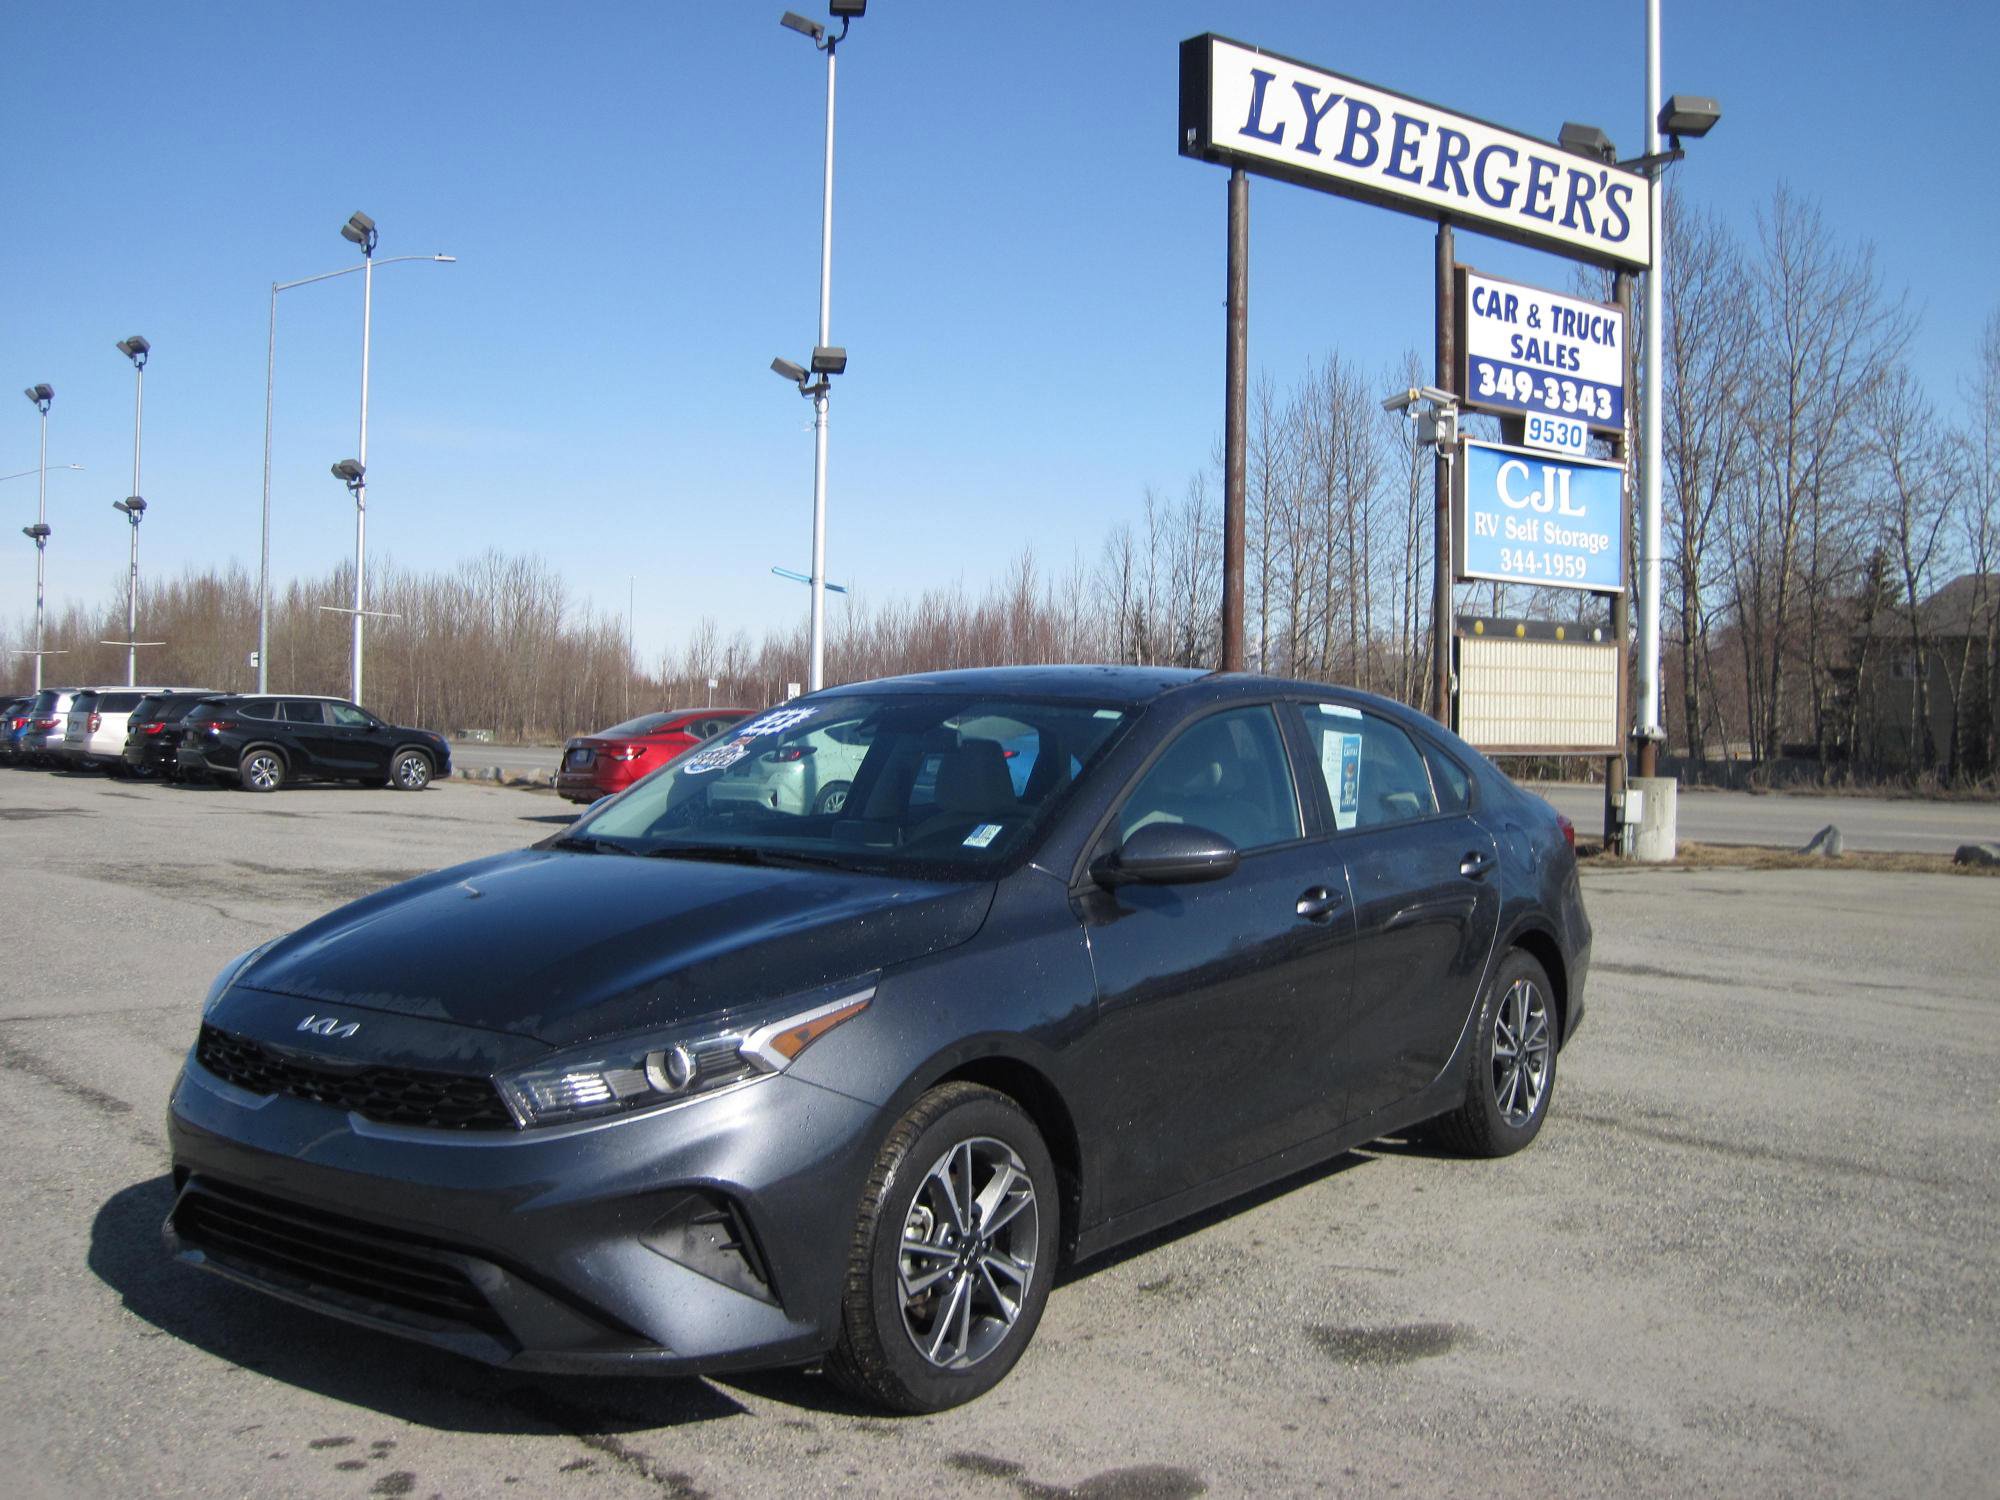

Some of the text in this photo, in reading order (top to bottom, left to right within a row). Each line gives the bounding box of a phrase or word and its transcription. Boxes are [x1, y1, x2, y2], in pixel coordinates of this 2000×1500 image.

[1238, 67, 1633, 243] LYBERGER'S
[1472, 286, 1616, 347] CAR & TRUCK
[1510, 333, 1580, 371] SALES
[1478, 363, 1612, 420] 349-3343
[1528, 417, 1582, 448] 9530
[1496, 459, 1586, 517] CJL
[1474, 512, 1609, 553] RV Self Storage
[1500, 548, 1586, 579] 344-1959
[297, 1014, 361, 1039] KIA
